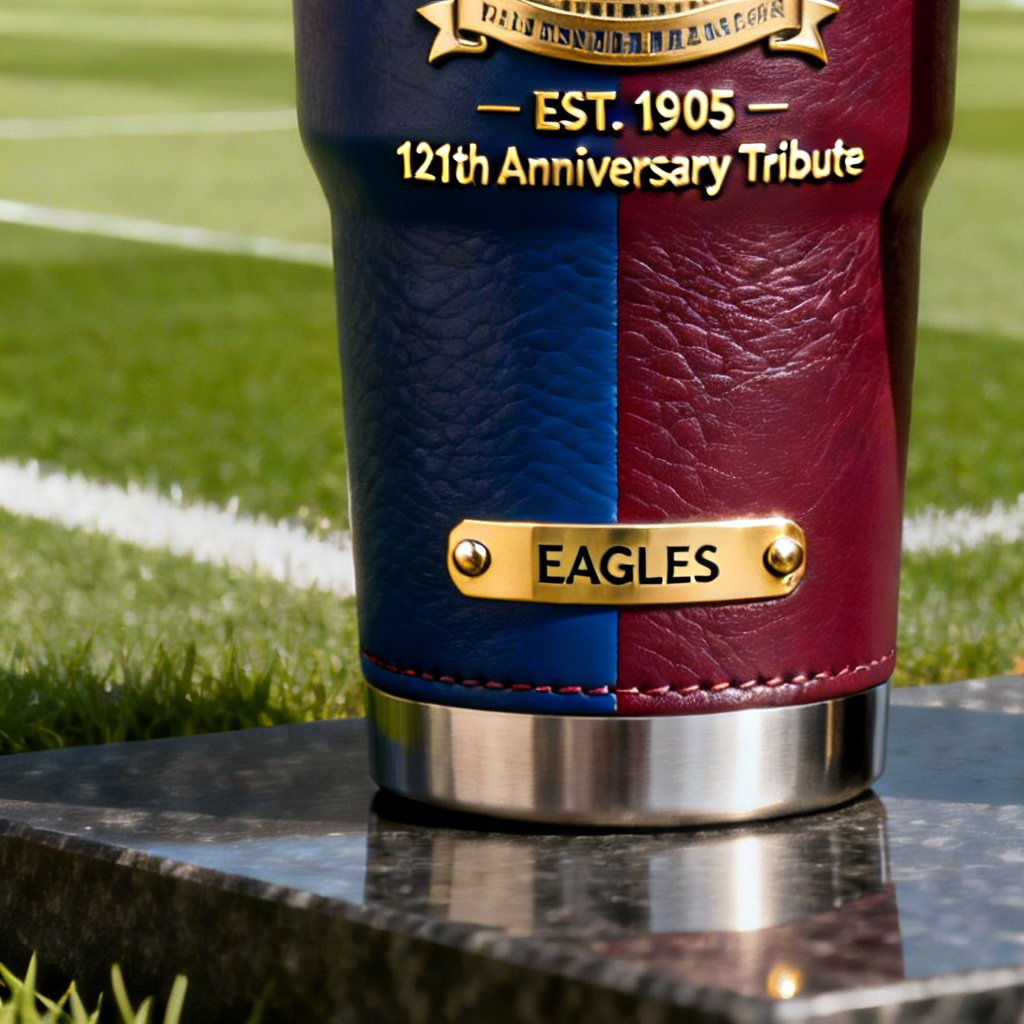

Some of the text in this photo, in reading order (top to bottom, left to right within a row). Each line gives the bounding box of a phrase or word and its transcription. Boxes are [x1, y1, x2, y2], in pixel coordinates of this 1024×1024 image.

[534, 89, 735, 132] EST. 1905
[396, 139, 865, 196] 121th Anniversary Tribute
[538, 544, 720, 585] EAGLES
